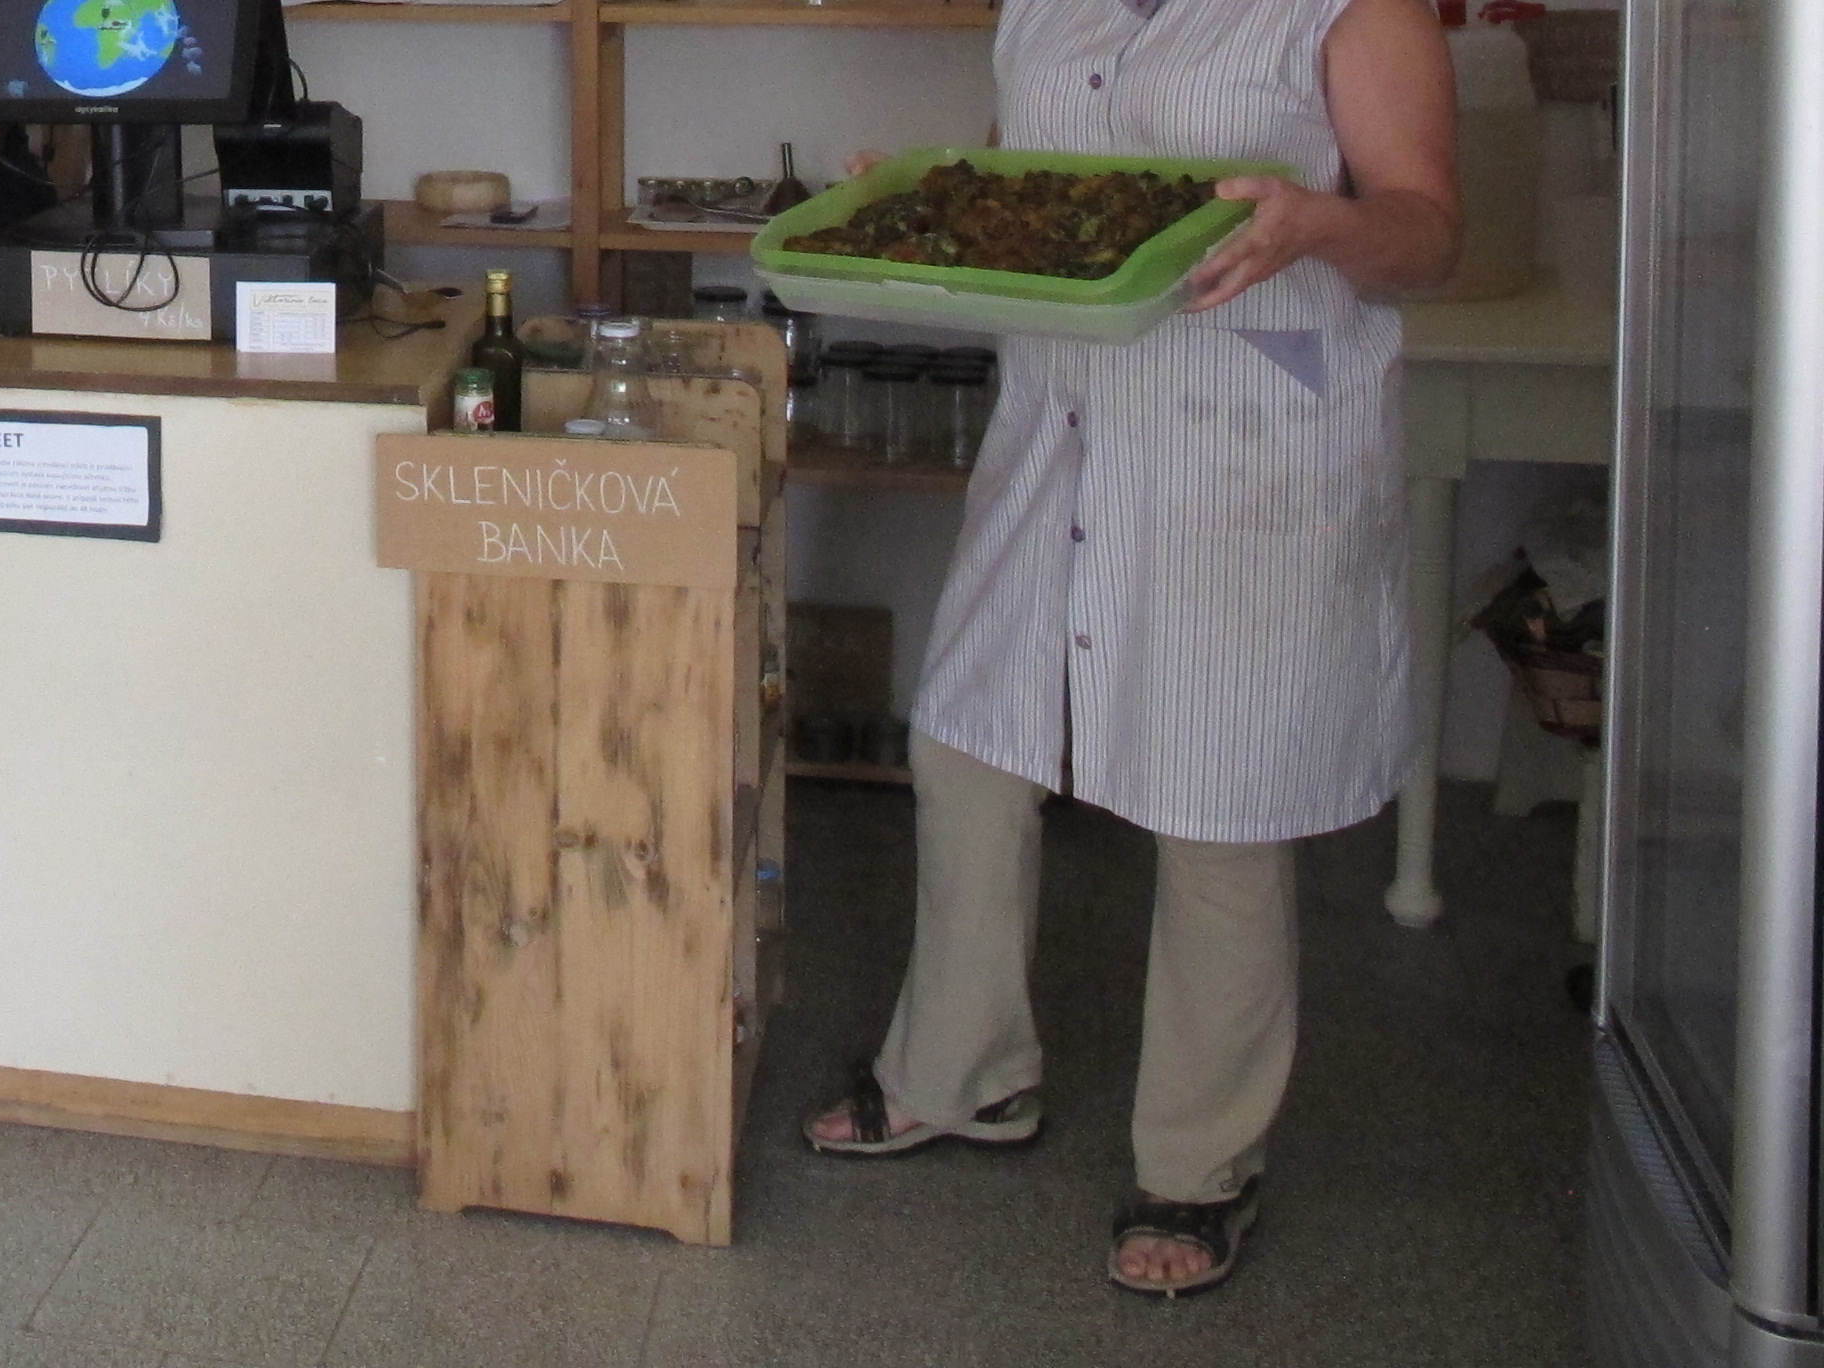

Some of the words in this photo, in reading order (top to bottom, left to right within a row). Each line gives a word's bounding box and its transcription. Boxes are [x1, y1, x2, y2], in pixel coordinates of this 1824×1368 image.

[40, 259, 173, 296] PYLÍKY
[394, 458, 680, 518] SKLENIČKOVÁ
[477, 520, 626, 572] BANKA
